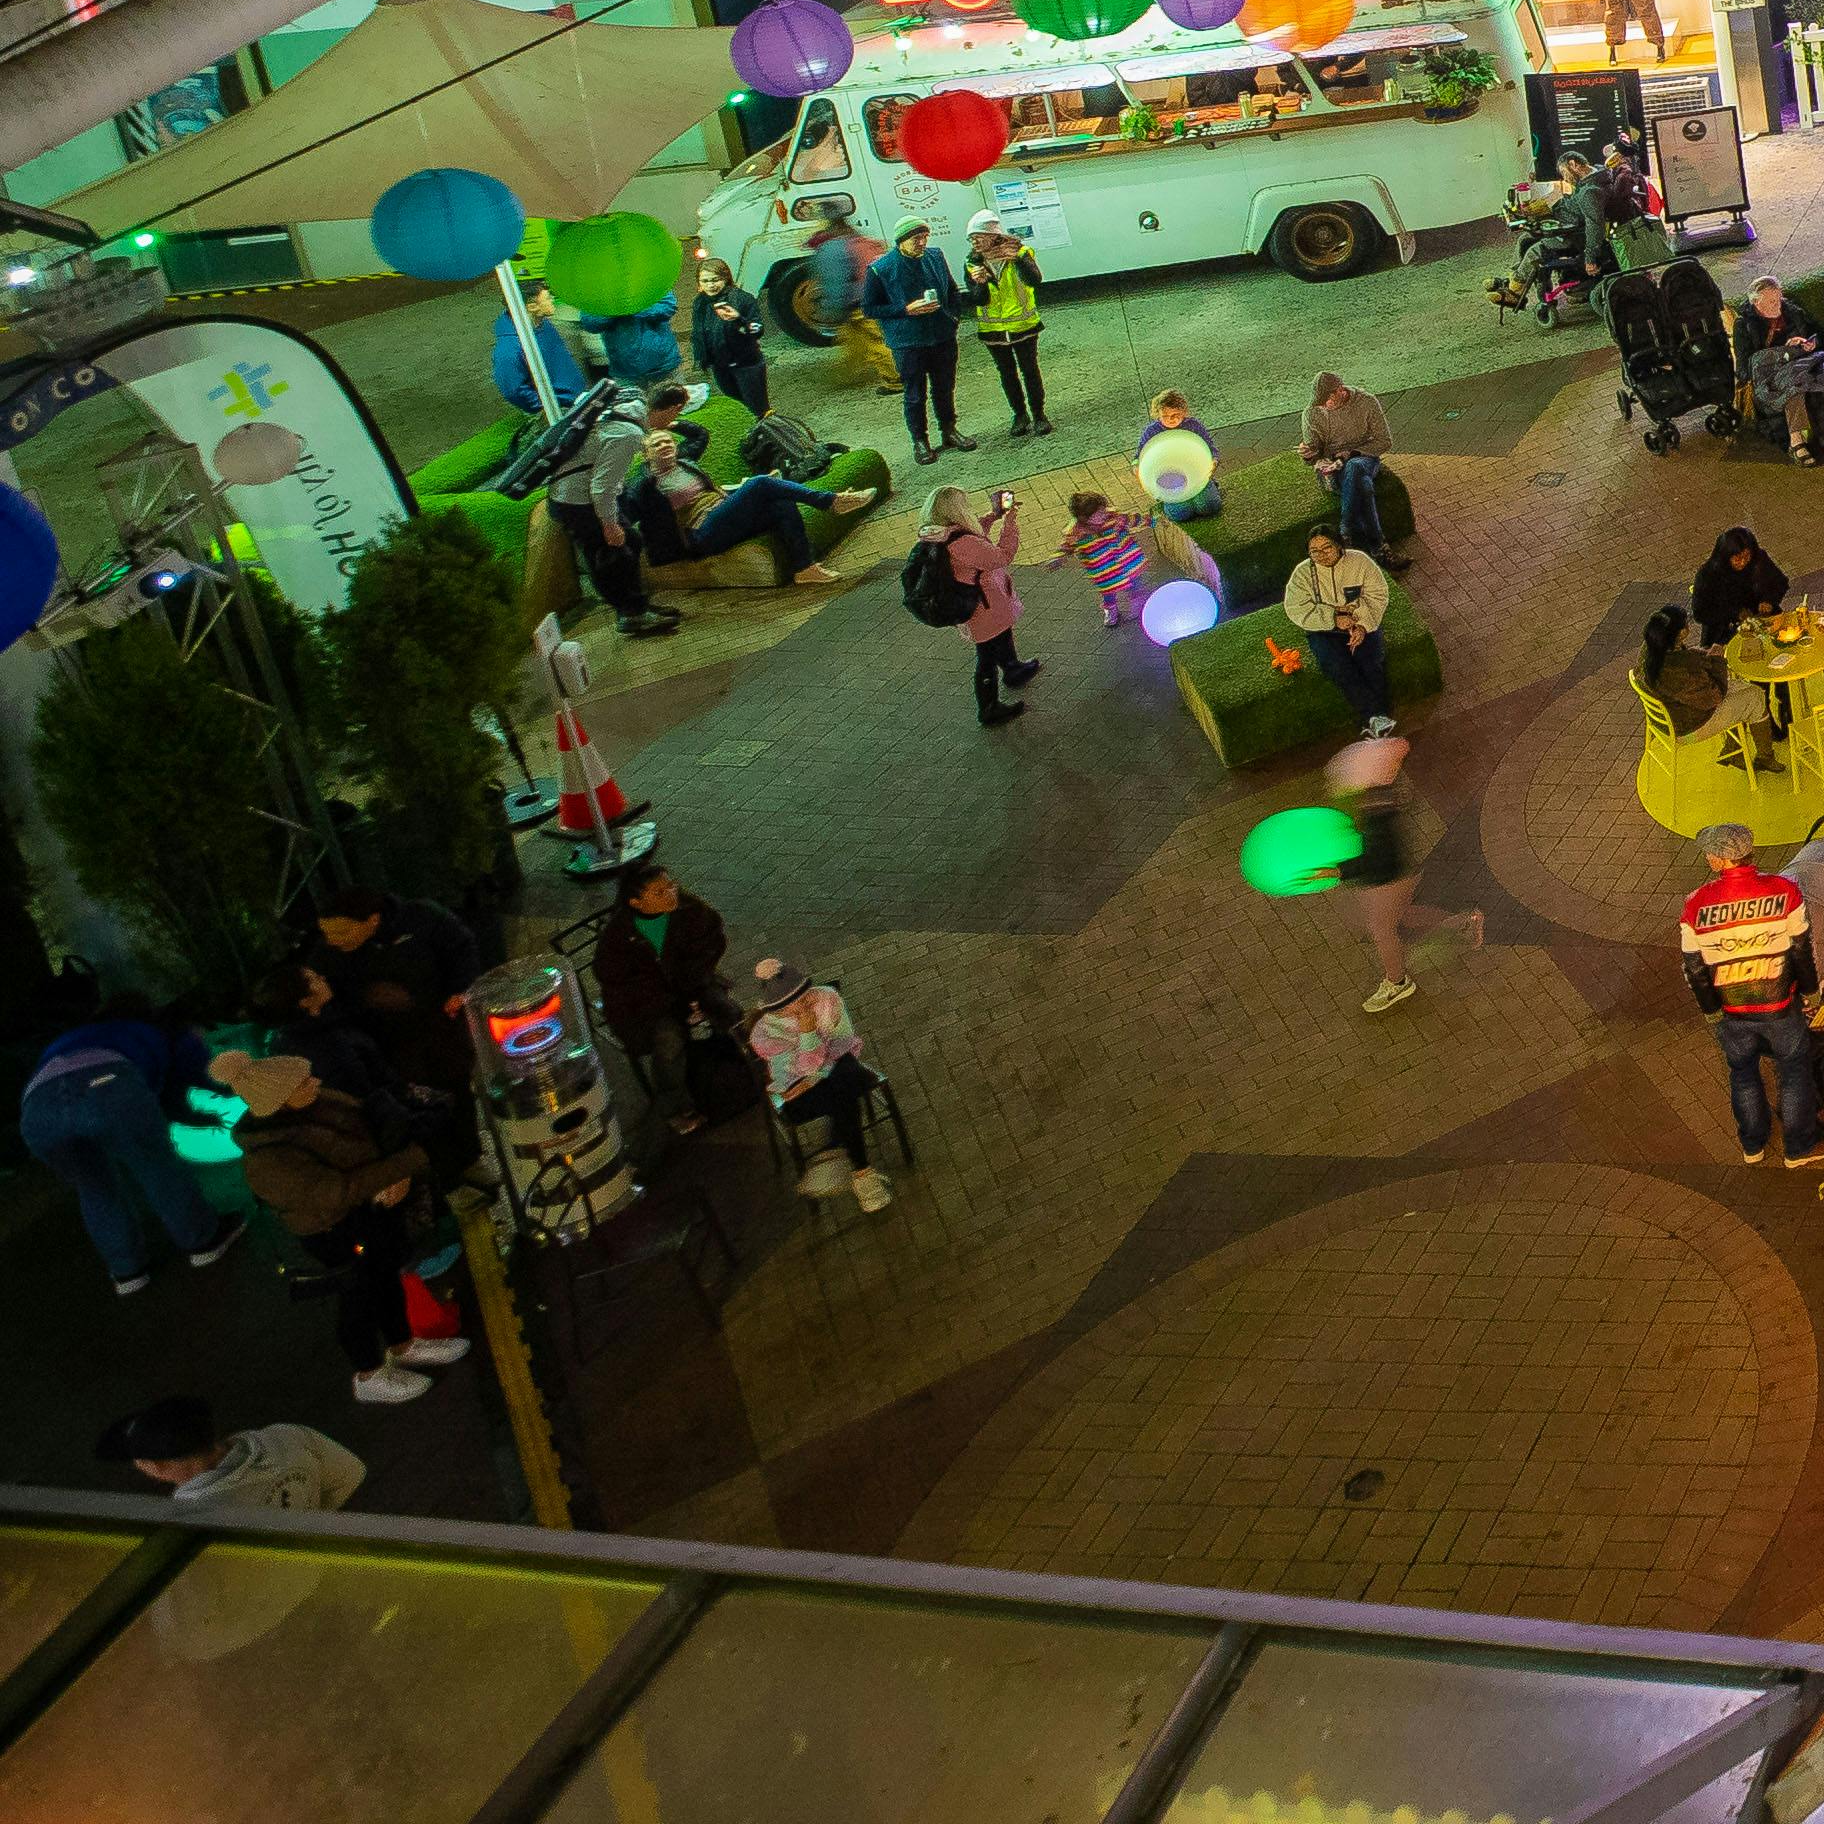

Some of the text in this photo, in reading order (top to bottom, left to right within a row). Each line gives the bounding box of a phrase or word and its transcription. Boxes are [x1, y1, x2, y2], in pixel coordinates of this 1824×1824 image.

[1720, 0, 1732, 8] THE
[901, 184, 932, 196] BAR
[1696, 894, 1787, 928] NEOVISION
[1713, 956, 1786, 987] RACING
